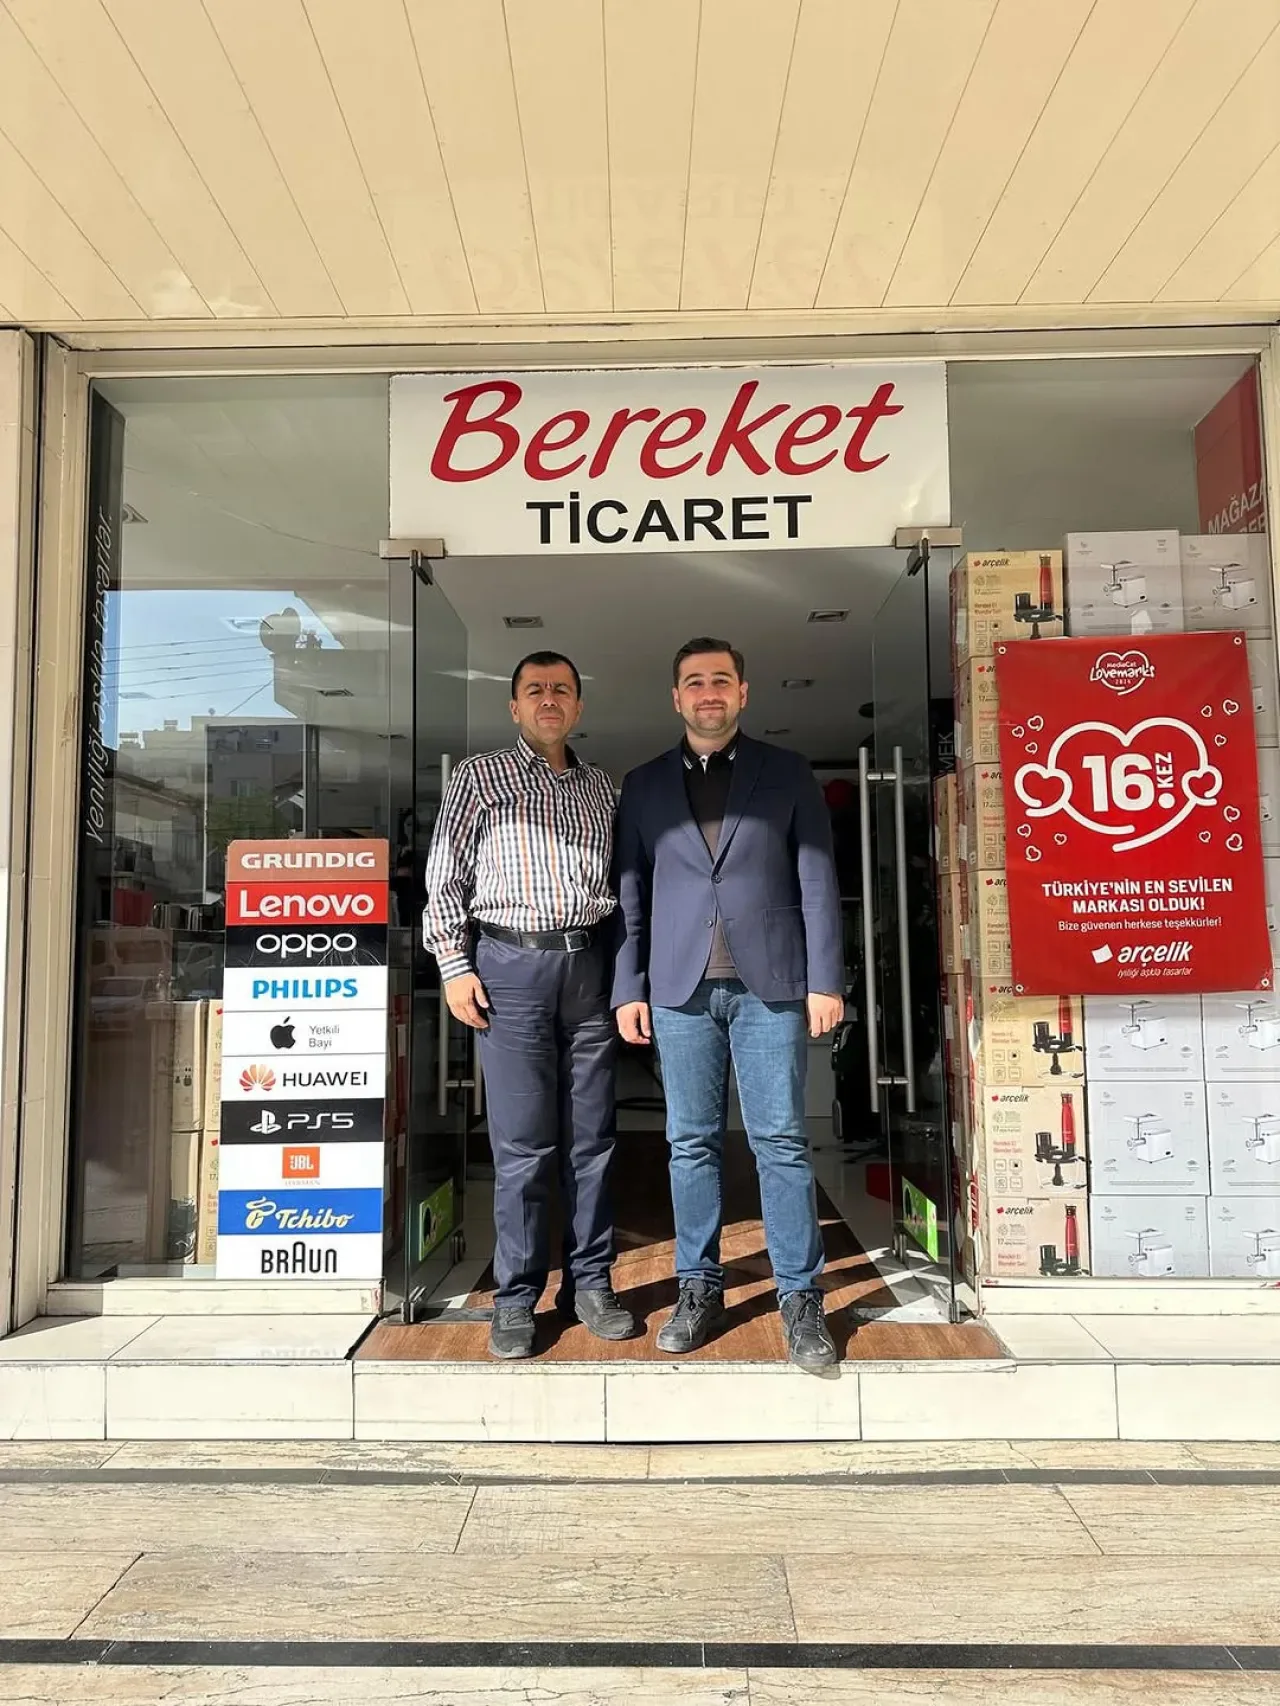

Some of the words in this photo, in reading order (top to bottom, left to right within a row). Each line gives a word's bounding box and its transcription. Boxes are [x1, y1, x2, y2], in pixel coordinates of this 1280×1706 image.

[430, 380, 904, 483] Bereket
[526, 491, 812, 544] TİCARET
[1154, 752, 1174, 788] KEZ
[240, 852, 376, 869] GRUNDIG
[1041, 878, 1141, 897] TÜRKİYE'NİN
[1144, 880, 1165, 894] EN
[1168, 876, 1233, 893] SEVİLEN
[239, 889, 375, 918] Lenovo
[1072, 898, 1145, 914] MARKASI
[1148, 896, 1205, 912] OLDUK!
[1058, 920, 1079, 931] Bize
[1081, 919, 1123, 933] güvenen
[1124, 918, 1163, 930] herkese
[1164, 916, 1222, 931] teşekkürler!
[256, 932, 357, 958] oppo
[1117, 941, 1193, 968] arçelik
[252, 978, 358, 999] PHILIPS
[309, 1024, 340, 1035] Yetkili
[308, 1037, 332, 1050] Bayi
[282, 1071, 368, 1087] HUAWEI
[287, 1112, 354, 1130] PS5
[289, 1155, 314, 1170] JBL
[275, 1208, 354, 1229] Tchibo
[261, 1241, 338, 1274] BRAUN
